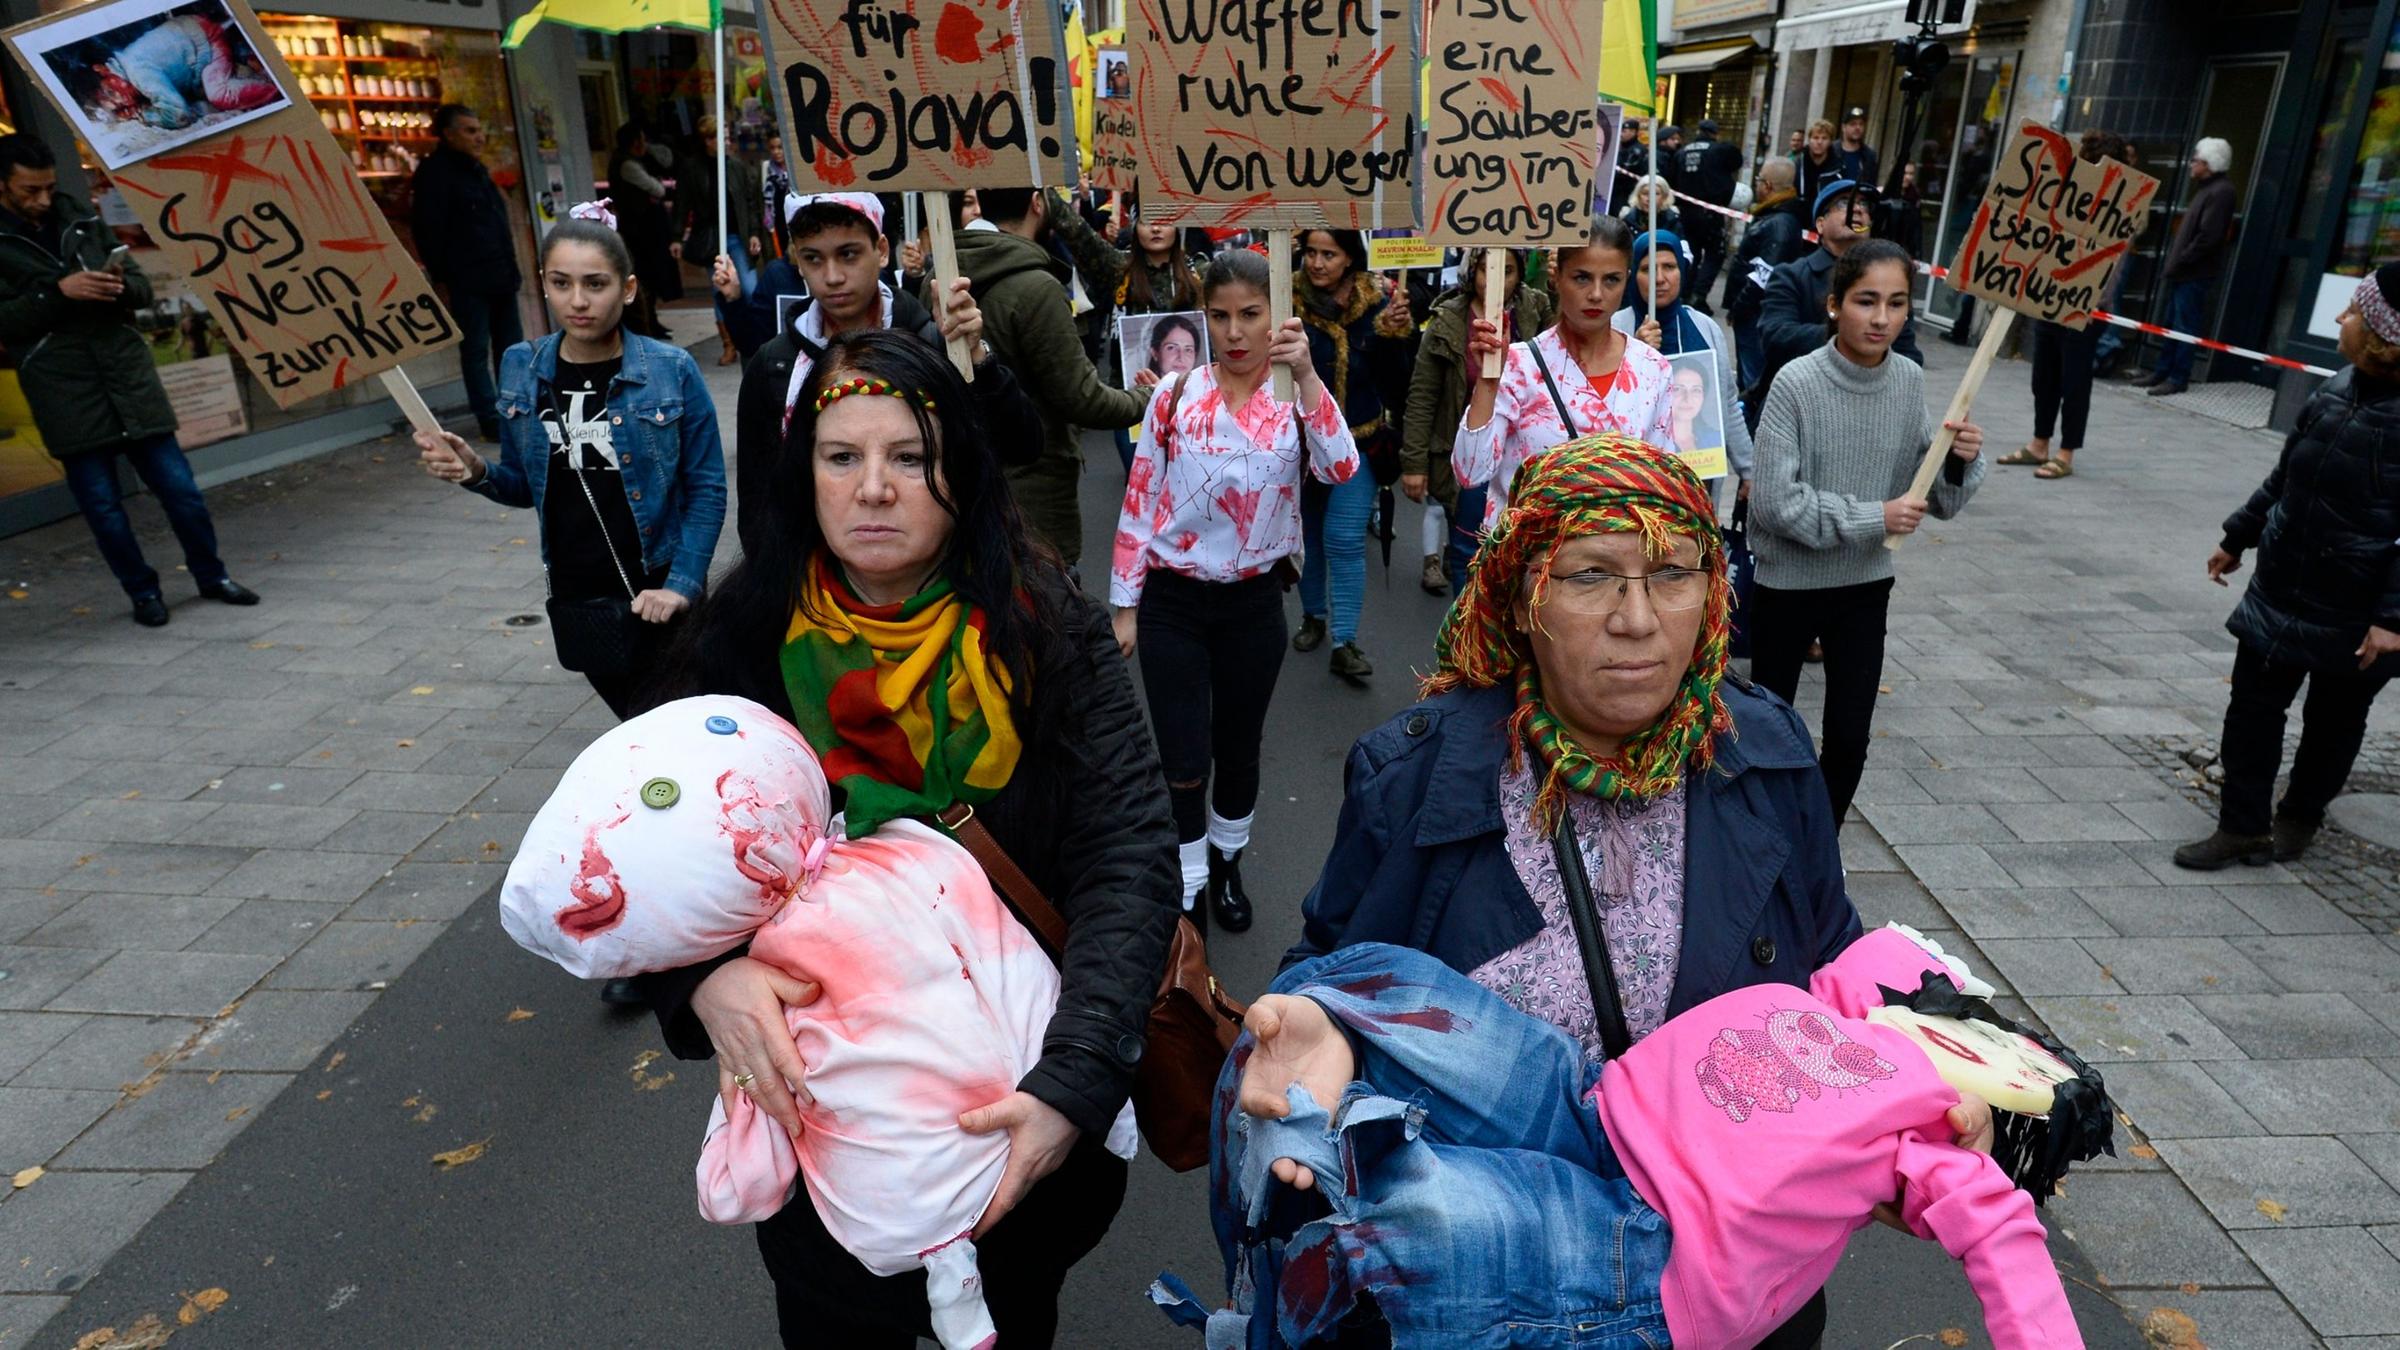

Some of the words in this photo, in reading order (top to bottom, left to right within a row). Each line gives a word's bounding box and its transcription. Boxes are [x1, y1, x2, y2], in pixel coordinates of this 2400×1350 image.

[840, 0, 920, 58] für
[1443, 41, 1555, 75] eine
[784, 57, 1060, 181] Rojava!
[1436, 80, 1594, 145] Säuber-
[1434, 151, 1507, 193] ung
[1520, 151, 1580, 187] im
[159, 193, 304, 277] Sag
[1446, 178, 1593, 241] Gange!
[214, 266, 362, 341] Nein
[334, 293, 452, 359] Krieg
[567, 425, 599, 439] Klein
